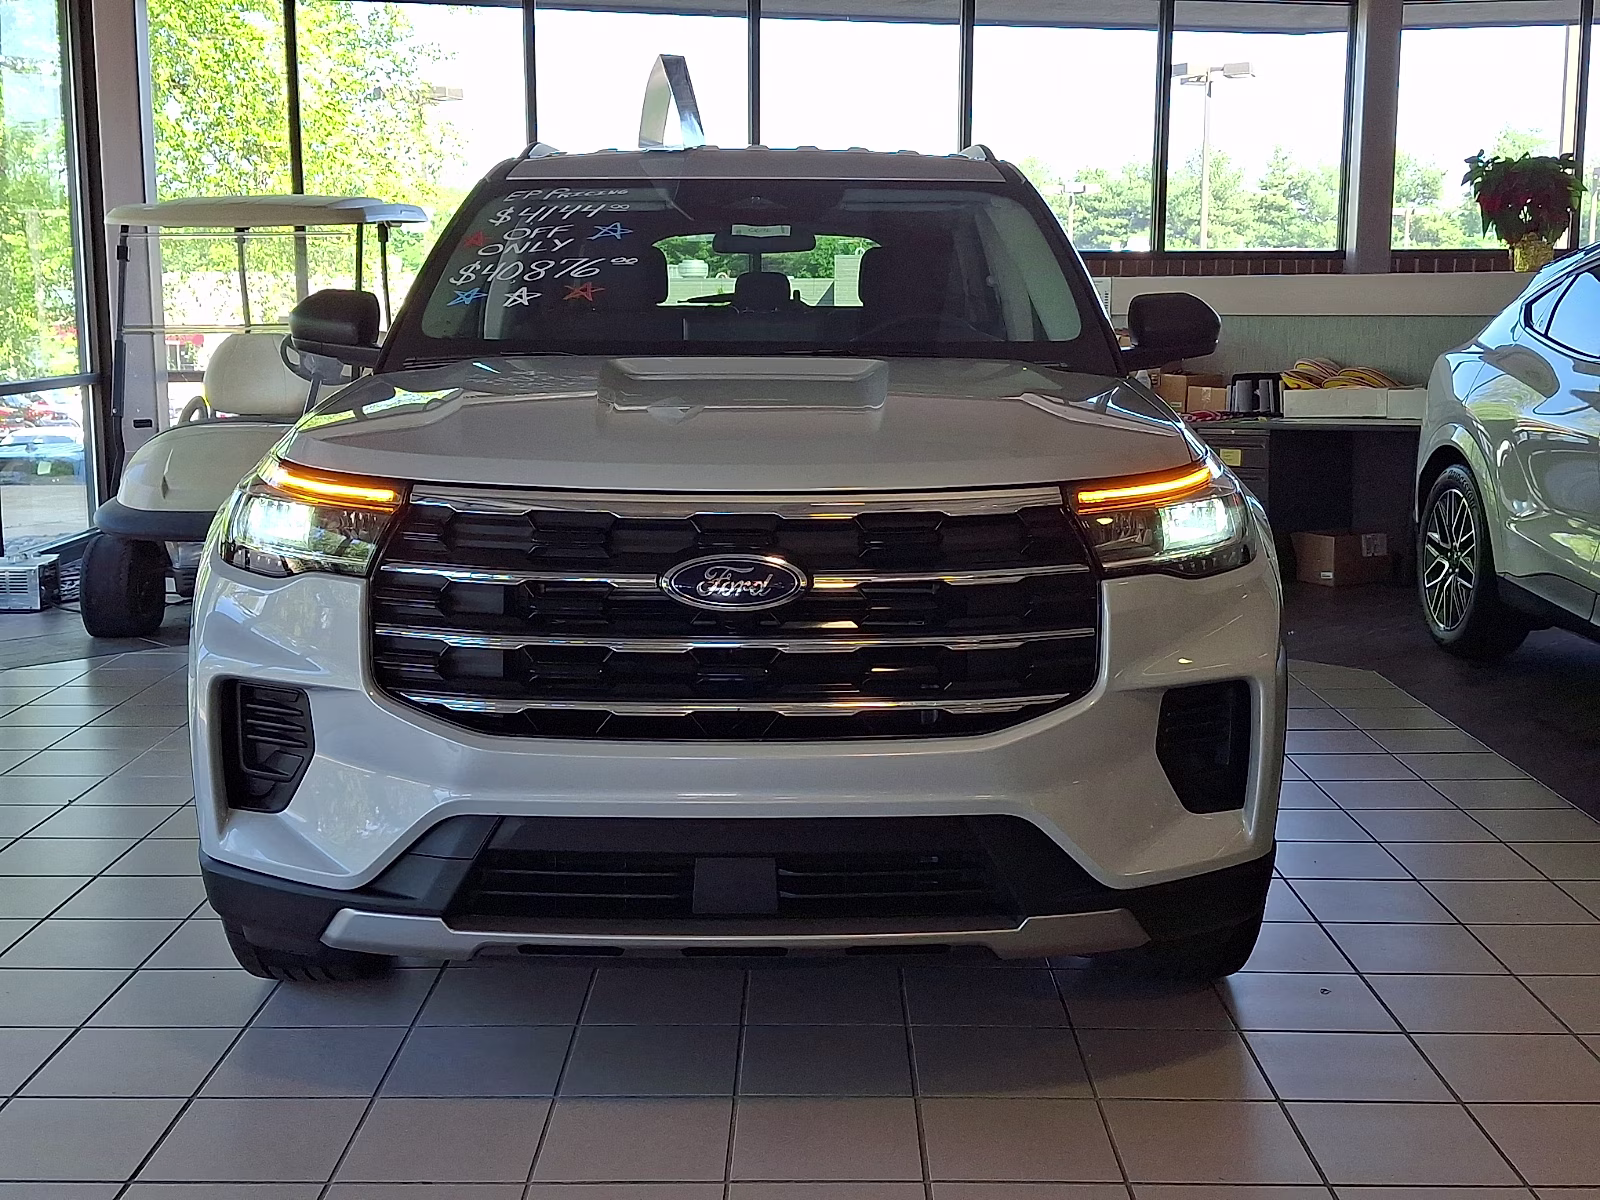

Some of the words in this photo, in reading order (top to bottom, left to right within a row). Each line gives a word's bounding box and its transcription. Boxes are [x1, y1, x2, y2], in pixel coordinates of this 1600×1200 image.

[502, 224, 575, 241] OFF
[477, 238, 576, 256] ONLY
[696, 565, 774, 597] Ford
